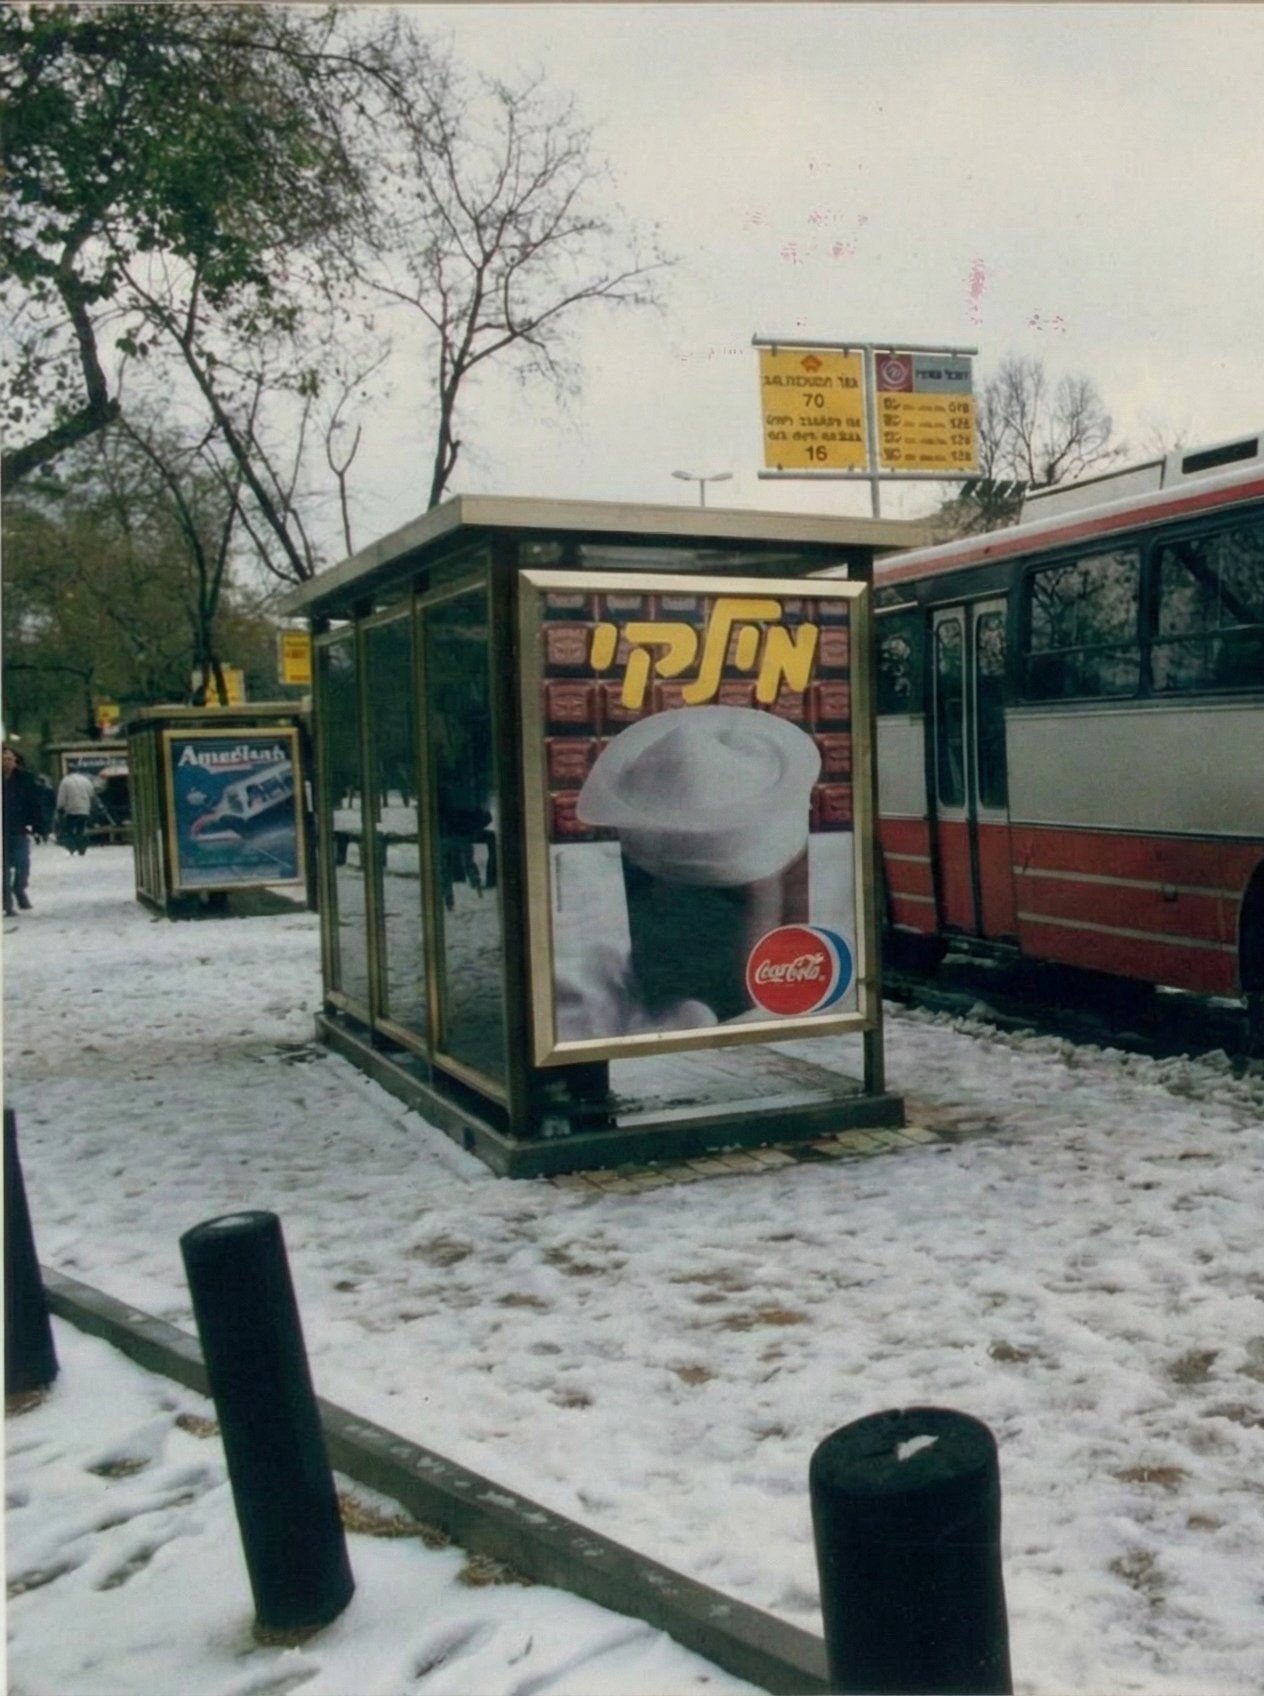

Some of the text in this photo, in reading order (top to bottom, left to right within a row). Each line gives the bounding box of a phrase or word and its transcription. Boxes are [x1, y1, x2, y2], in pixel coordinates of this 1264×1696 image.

[802, 393, 824, 408] 70
[805, 444, 828, 462] 16
[590, 597, 820, 710] מילקי
[754, 952, 826, 985] Coca-Cola
